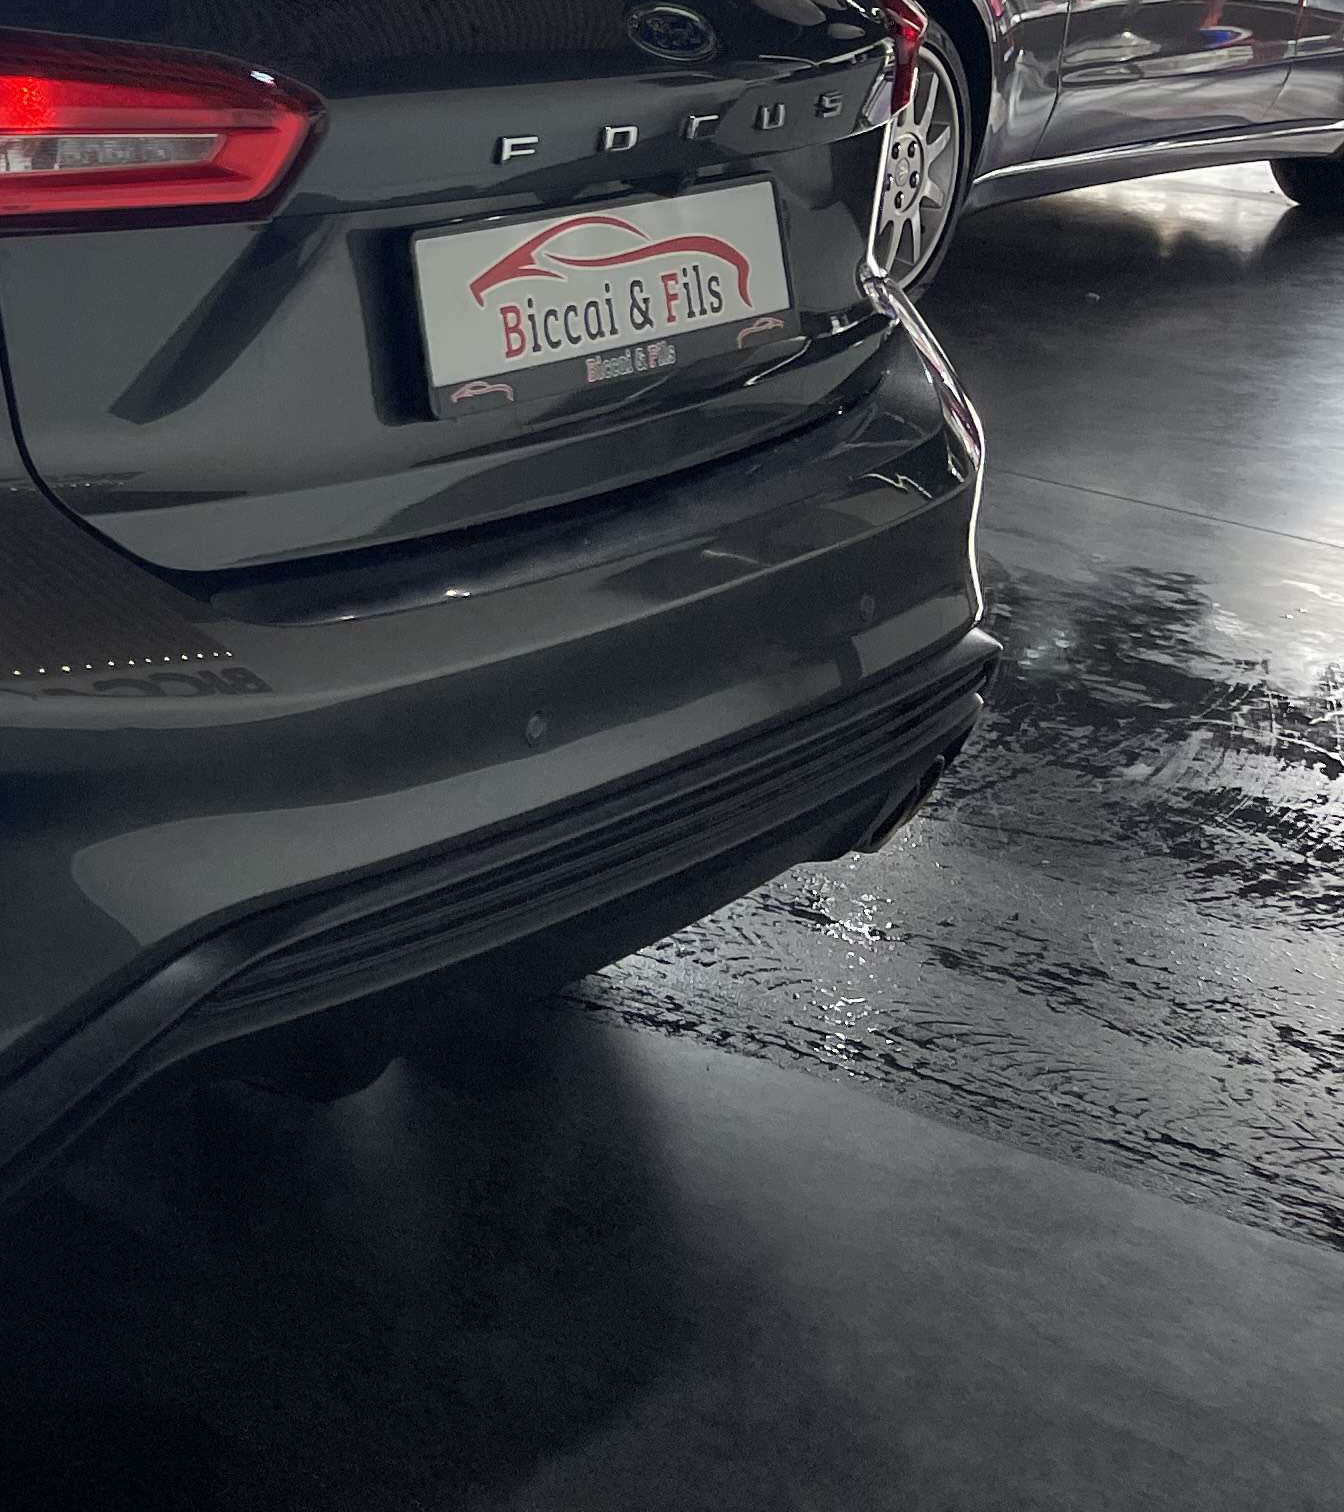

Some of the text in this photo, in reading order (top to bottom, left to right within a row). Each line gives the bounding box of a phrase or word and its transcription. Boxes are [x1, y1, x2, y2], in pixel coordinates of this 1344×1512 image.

[497, 90, 844, 161] FOCUS
[499, 265, 723, 359] Biccai & Fils
